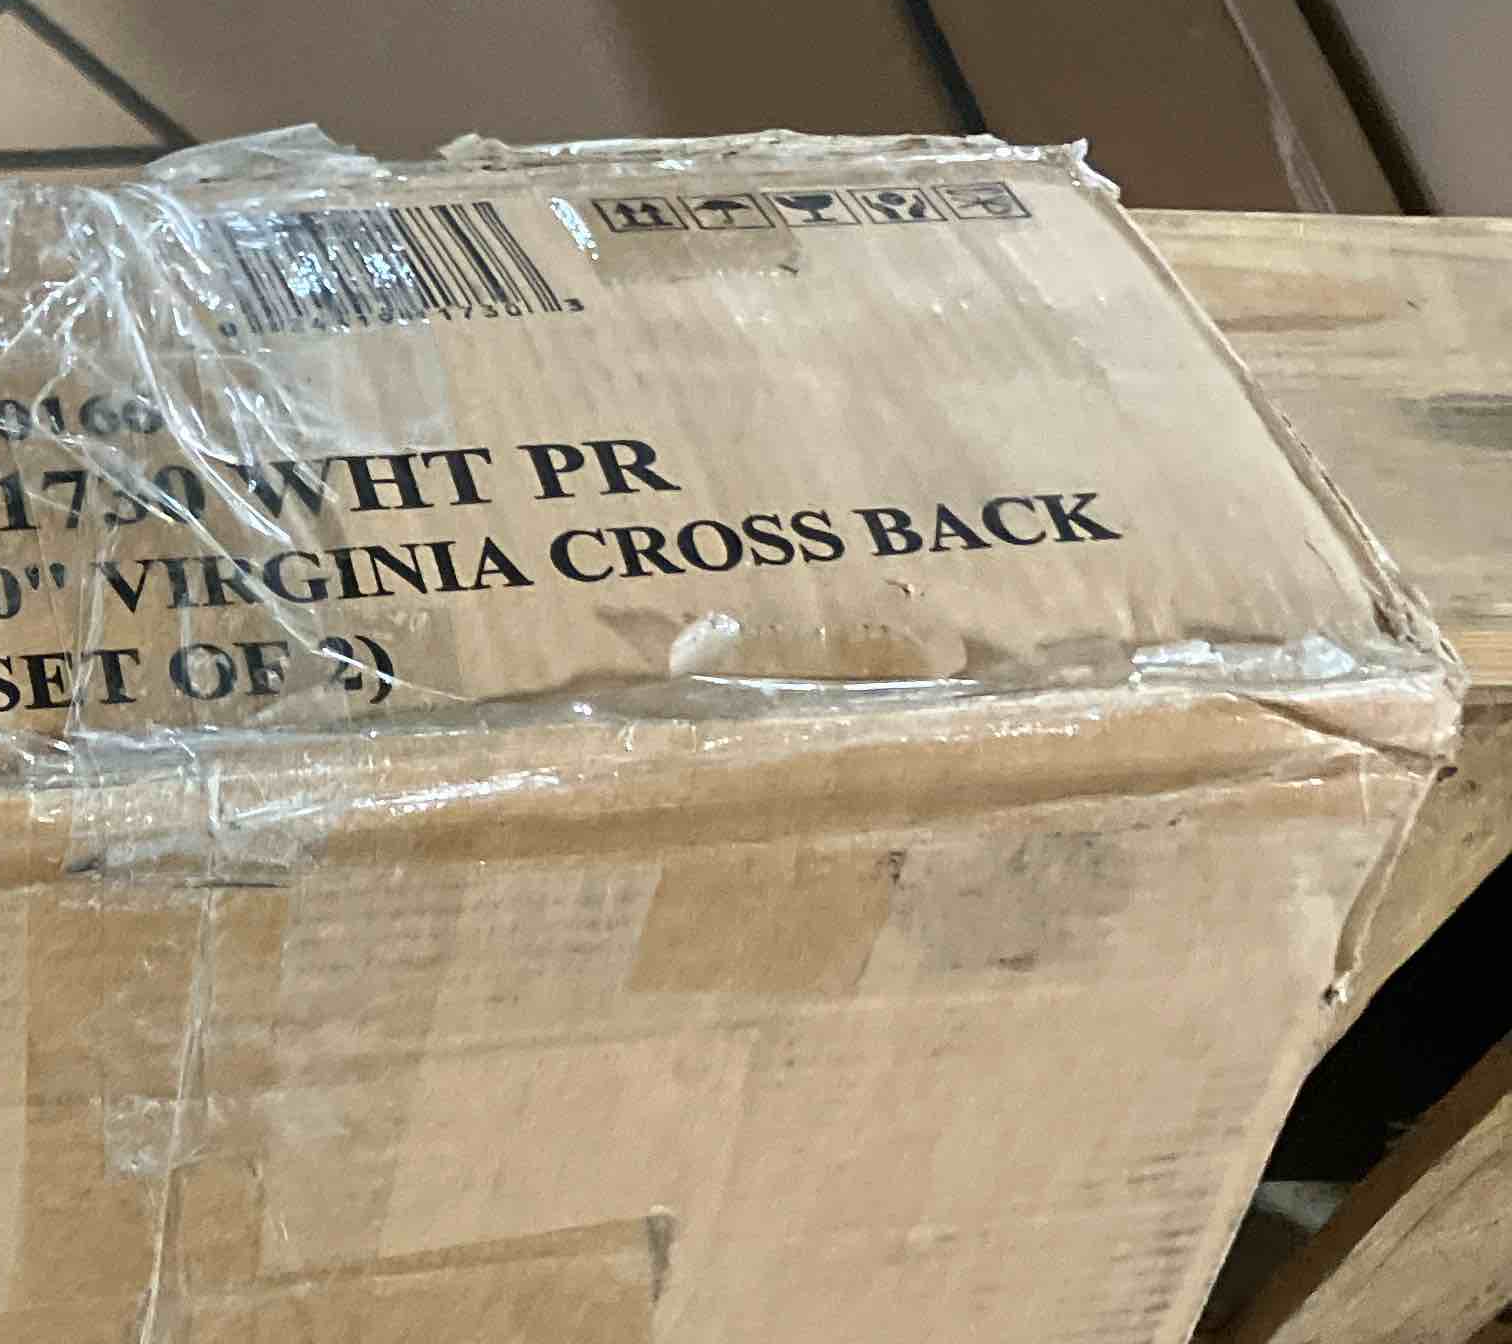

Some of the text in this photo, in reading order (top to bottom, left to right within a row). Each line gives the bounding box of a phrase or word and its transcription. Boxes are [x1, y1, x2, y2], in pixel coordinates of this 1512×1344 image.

[220, 449, 492, 518] WHT
[516, 438, 682, 500] PR
[91, 535, 534, 613] VIRGINIA
[549, 507, 845, 584] CROSS
[852, 491, 1123, 558] BACK
[169, 640, 289, 701] OF
